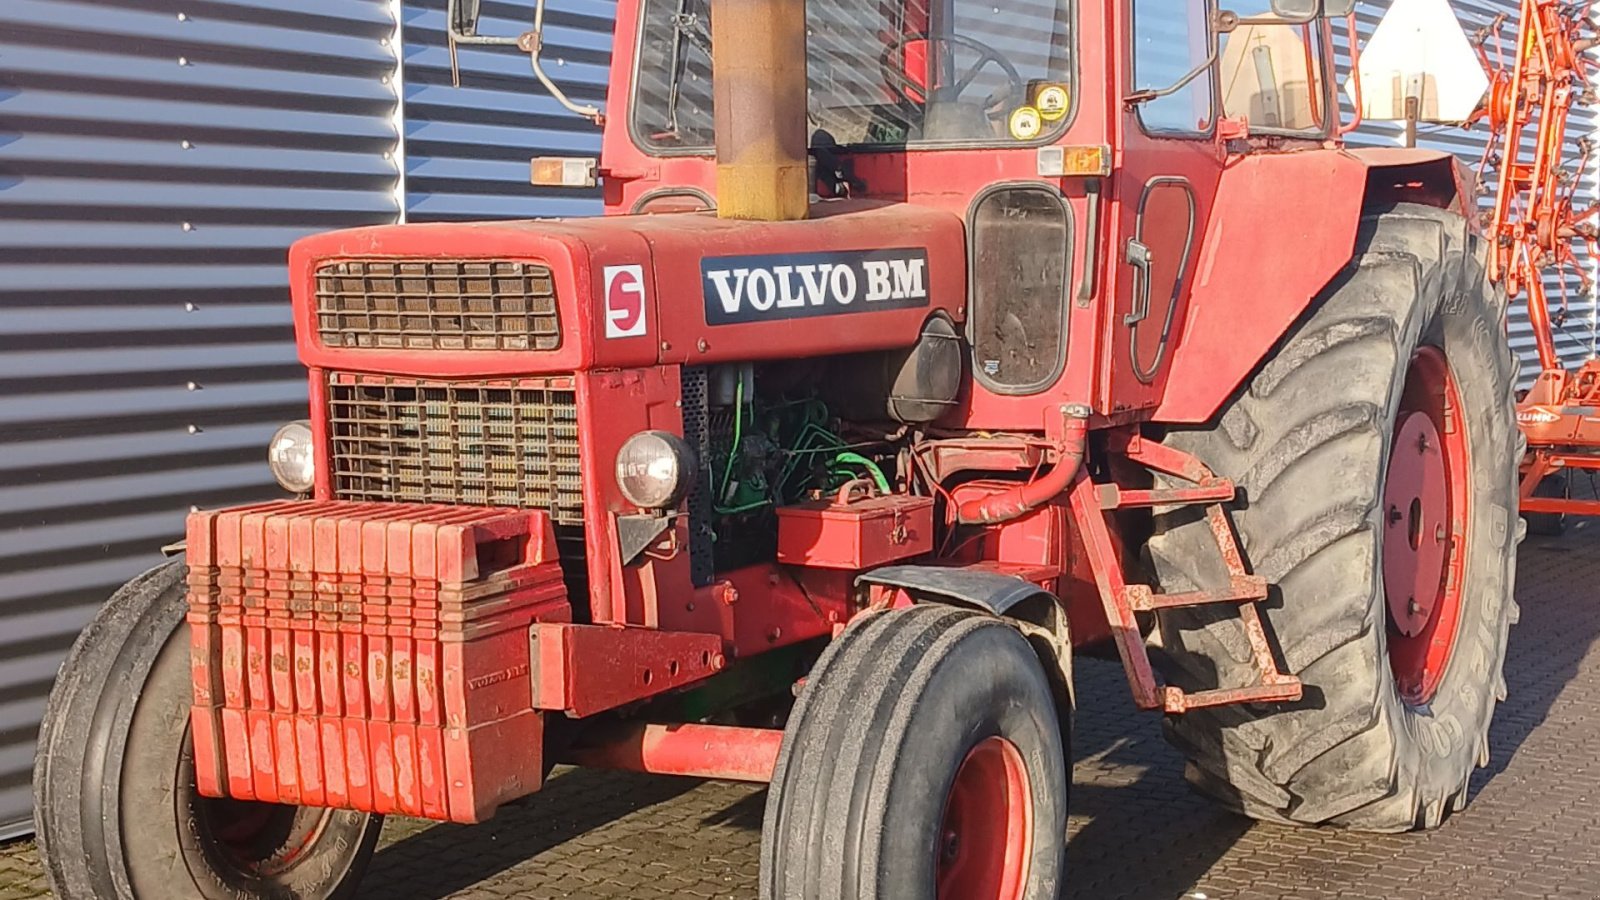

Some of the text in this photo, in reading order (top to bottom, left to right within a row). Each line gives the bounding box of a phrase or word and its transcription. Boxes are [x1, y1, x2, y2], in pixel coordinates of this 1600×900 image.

[608, 269, 642, 332] S
[707, 258, 927, 313] VOLVO BM
